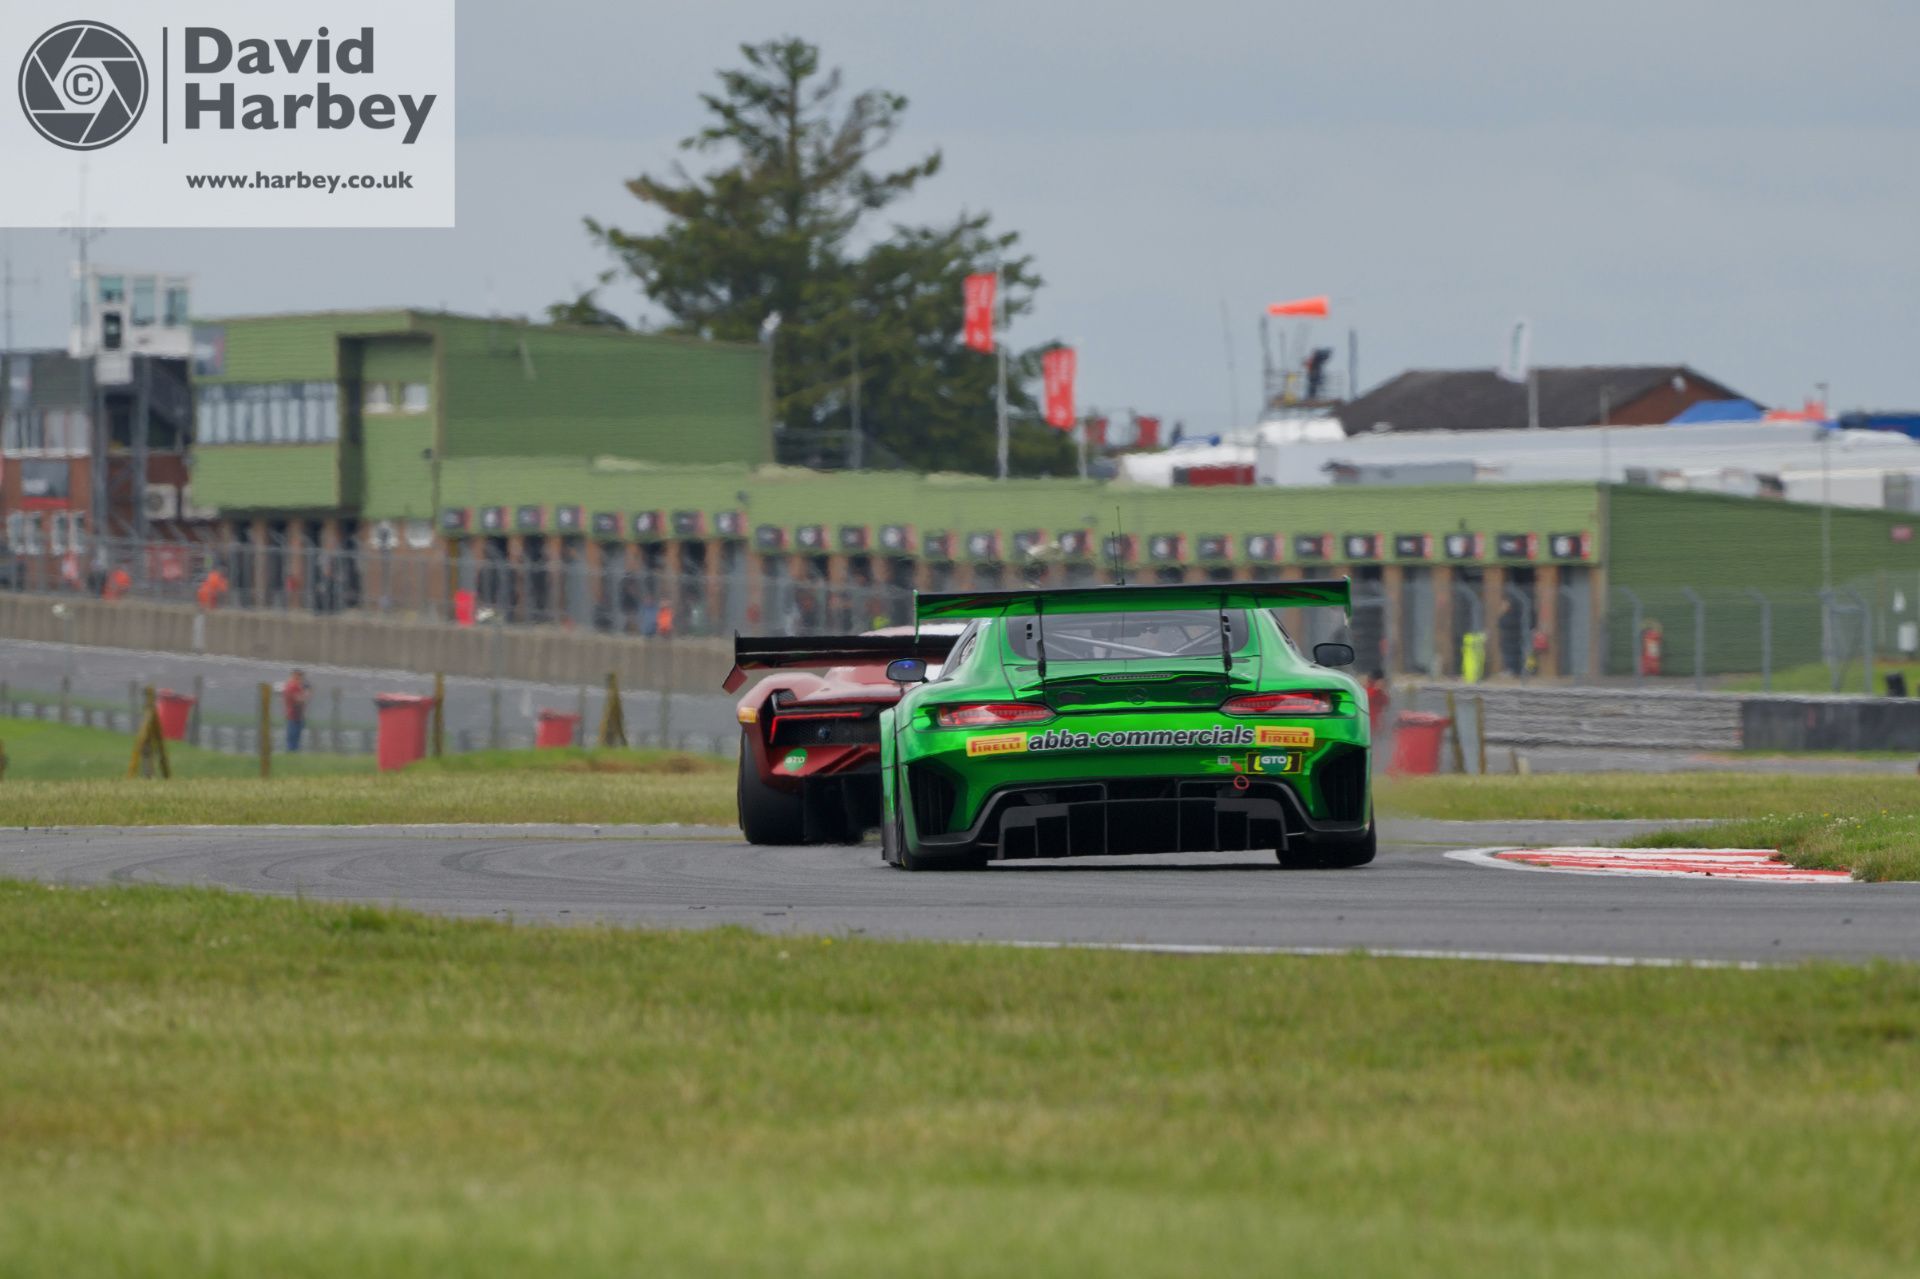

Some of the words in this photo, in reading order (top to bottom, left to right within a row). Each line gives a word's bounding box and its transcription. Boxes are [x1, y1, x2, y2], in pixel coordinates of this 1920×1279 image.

[1260, 729, 1310, 744] PIRELLI
[971, 736, 1021, 754] PIRELLI
[1261, 755, 1287, 765] GTO
